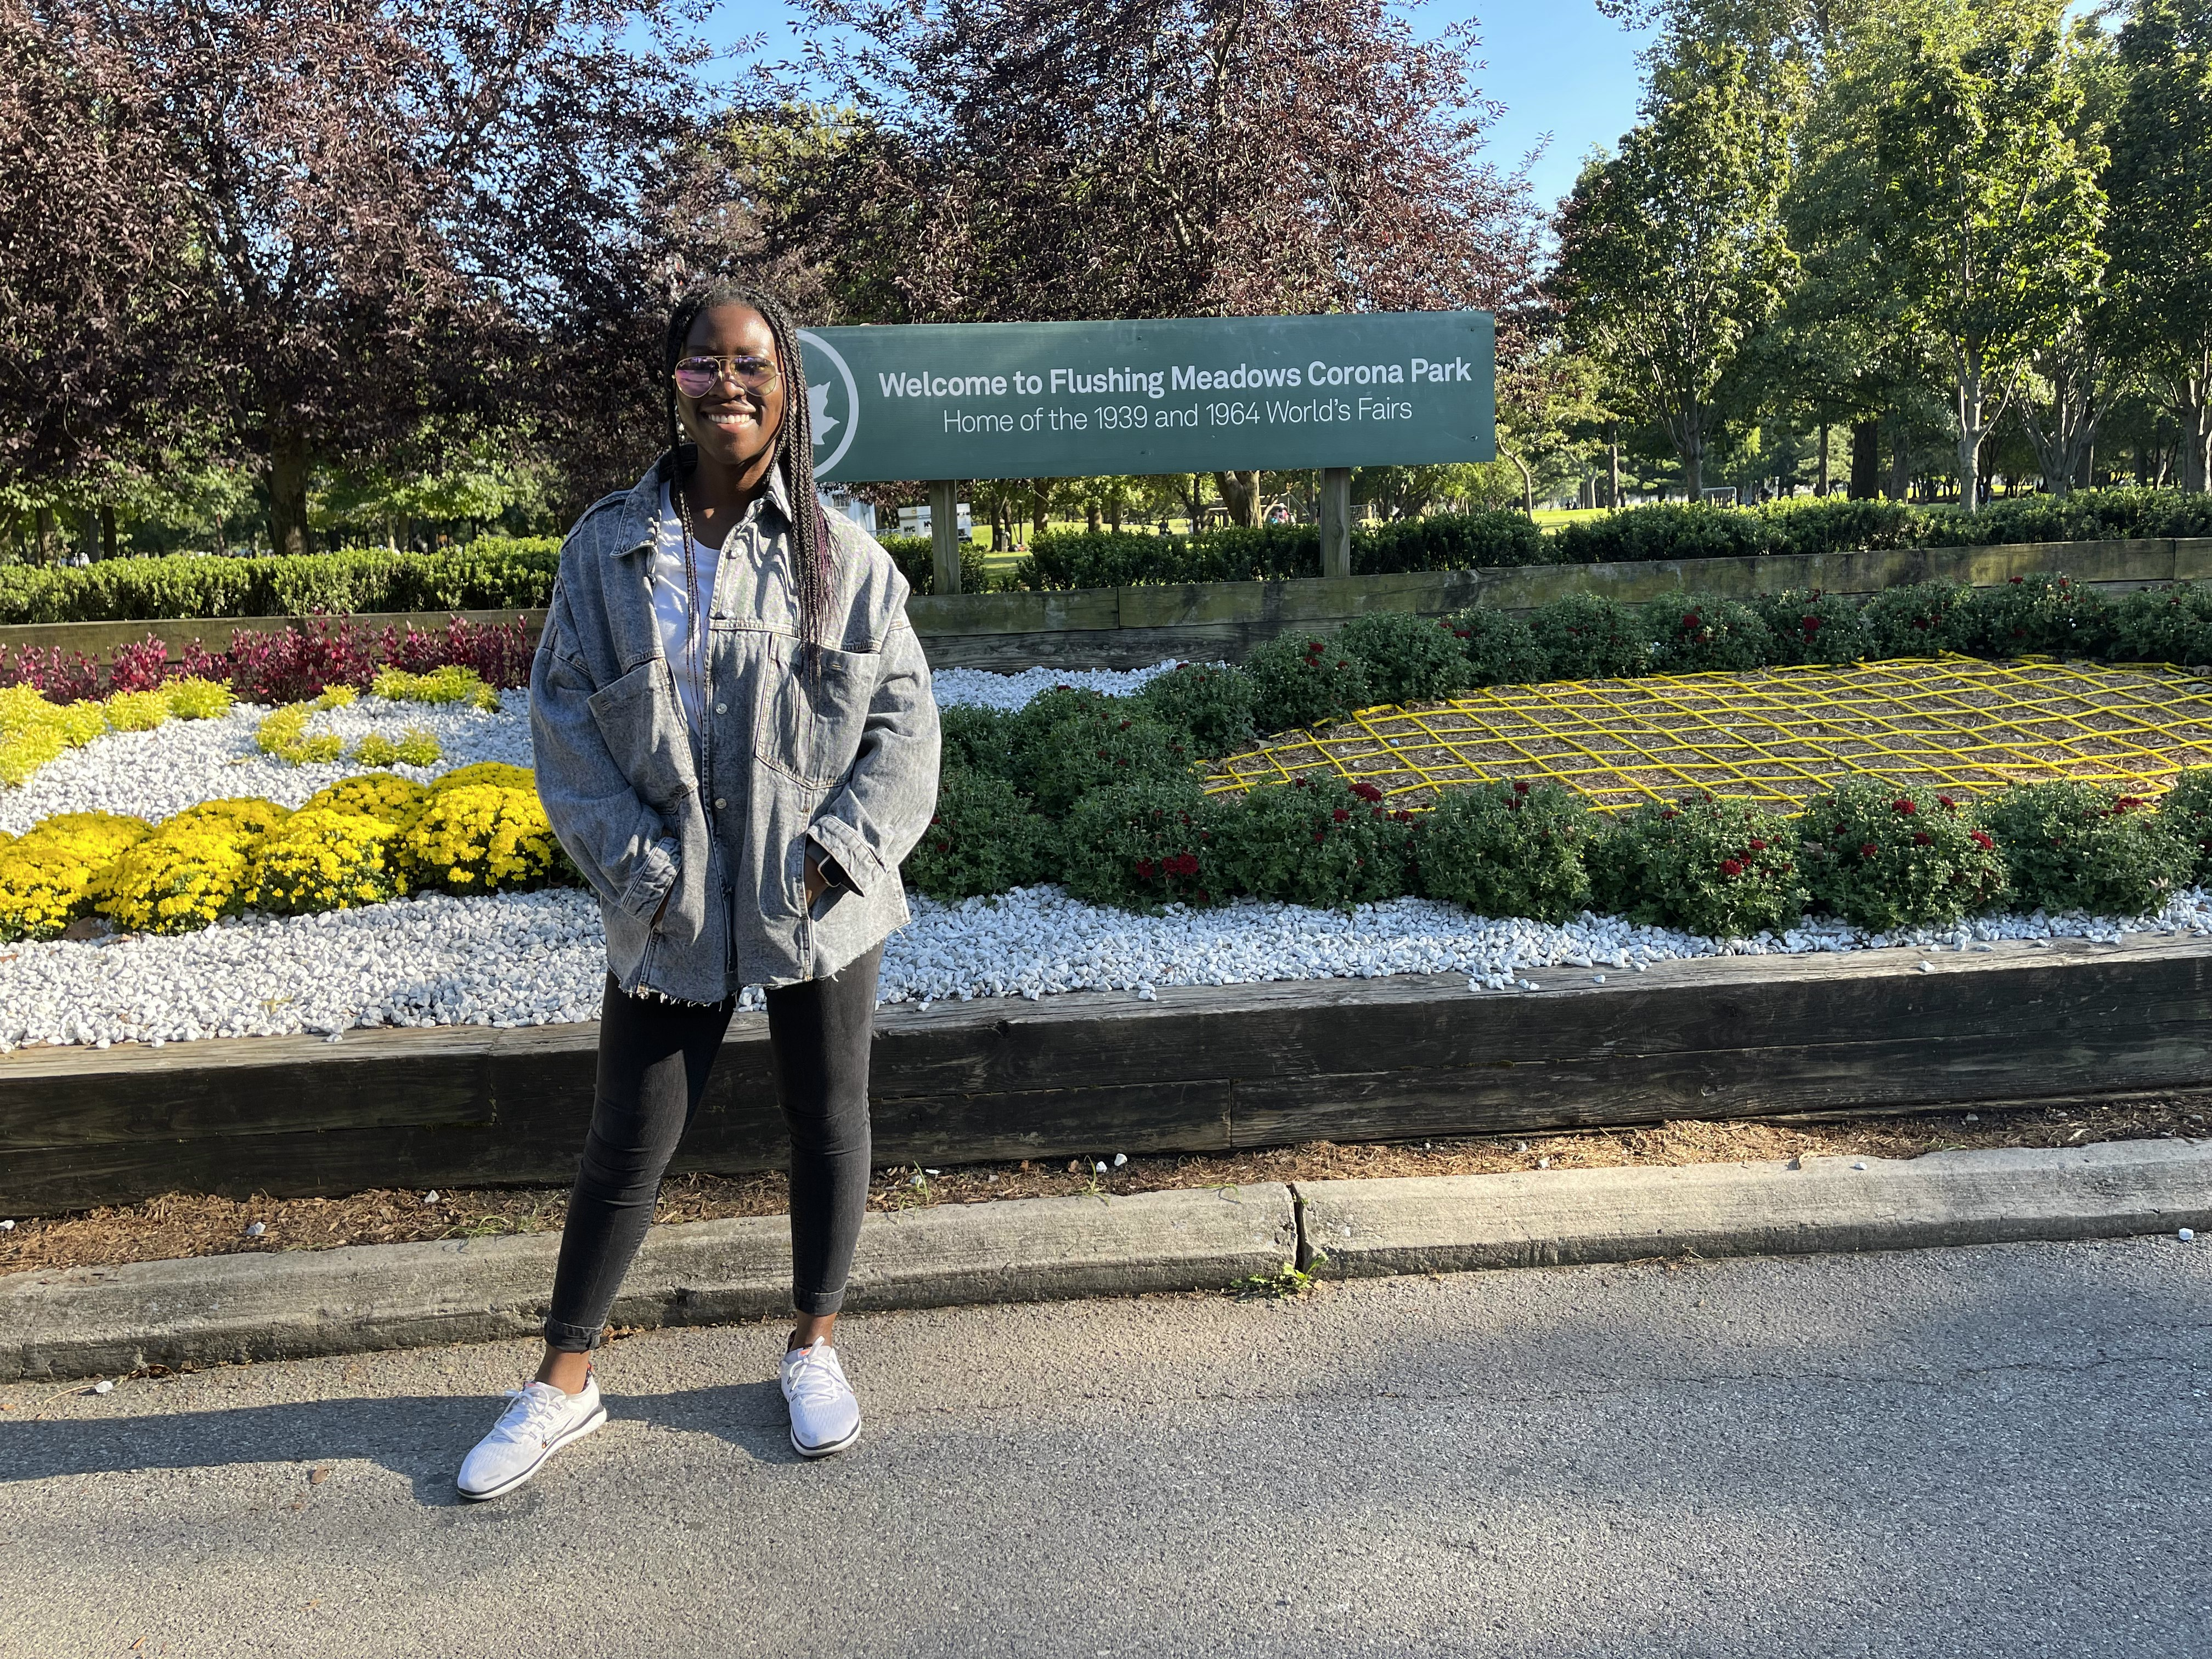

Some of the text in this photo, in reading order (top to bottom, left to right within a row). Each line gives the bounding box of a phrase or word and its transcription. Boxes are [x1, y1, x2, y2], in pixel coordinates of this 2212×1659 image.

[878, 357, 1472, 399] Welcome to Flushing Meadows Corona Park
[944, 409, 1013, 433] Home
[1020, 407, 1044, 431] of
[1048, 407, 1088, 431] the
[1093, 405, 1148, 430] 1939
[1154, 403, 1199, 428] and
[1206, 402, 1261, 426] 1964
[1358, 397, 1412, 421] Fairs
